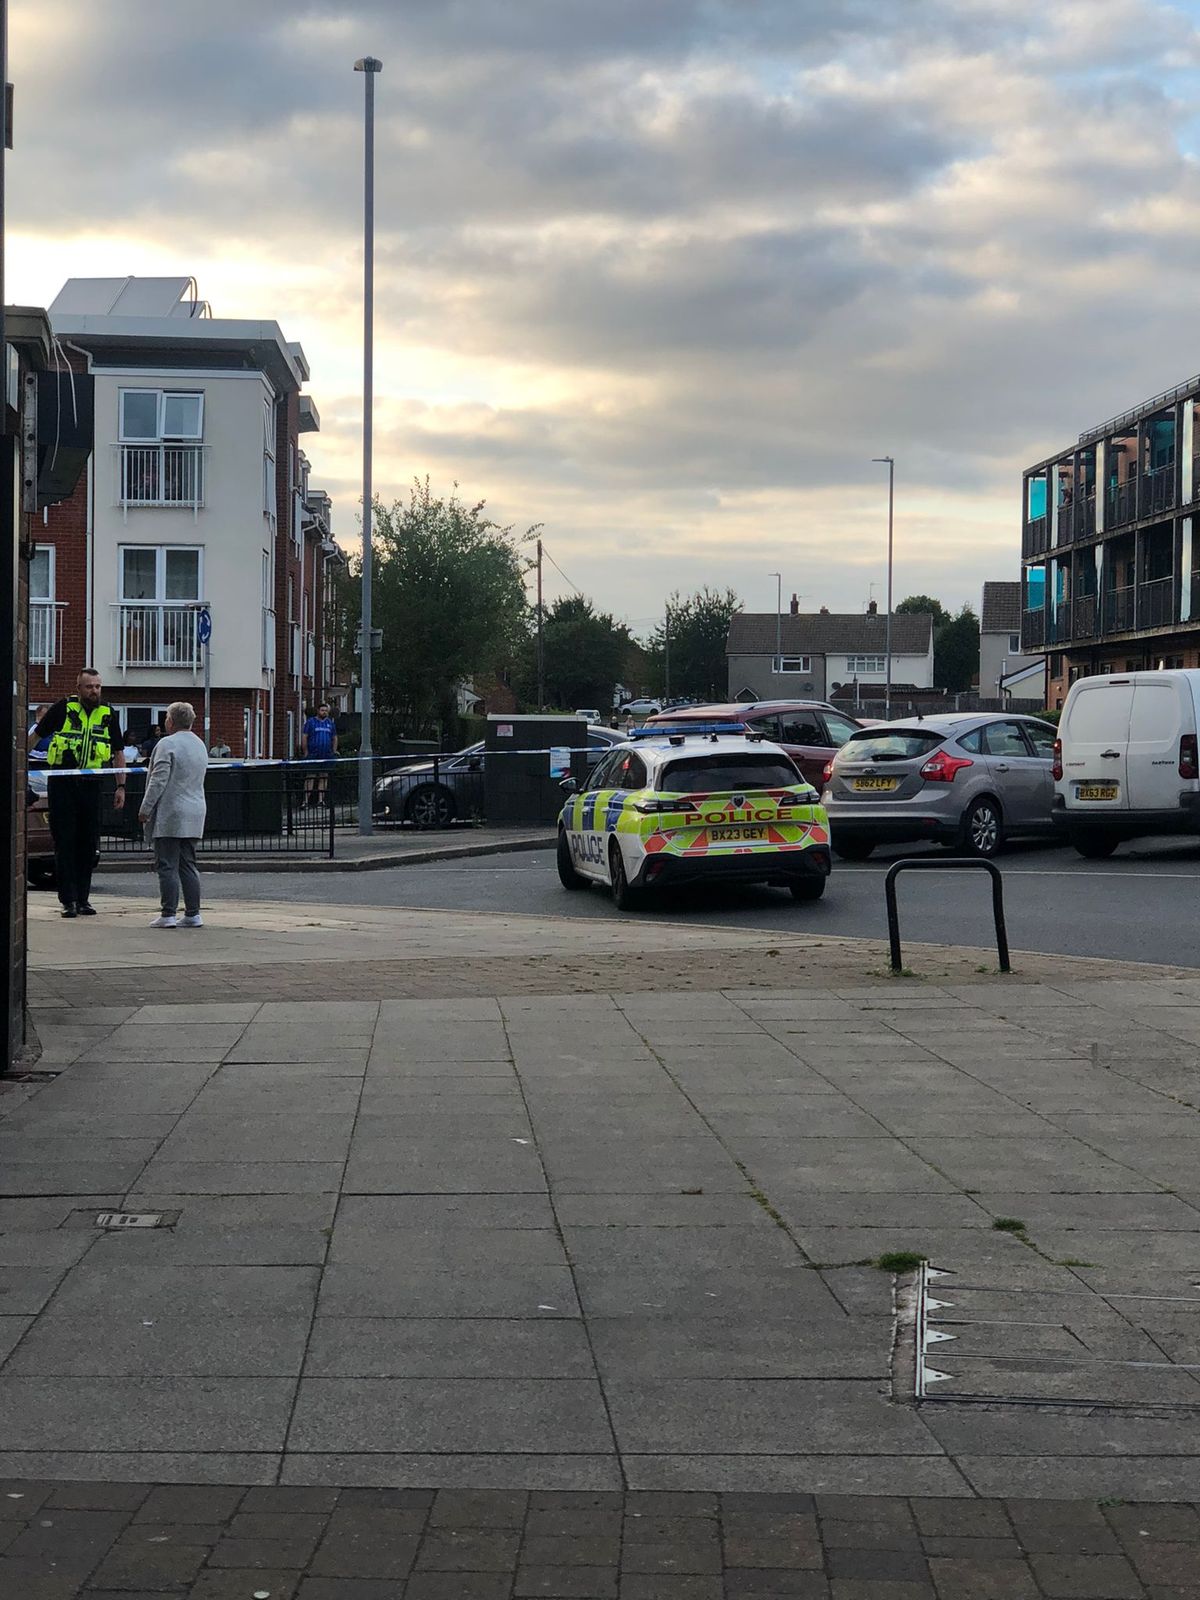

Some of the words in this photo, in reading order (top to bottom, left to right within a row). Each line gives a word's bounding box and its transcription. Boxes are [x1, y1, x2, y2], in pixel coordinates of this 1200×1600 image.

[685, 808, 793, 826] POLICE
[711, 829, 740, 841] BX23
[743, 828, 764, 840] GEY
[571, 834, 605, 866] POLICE
